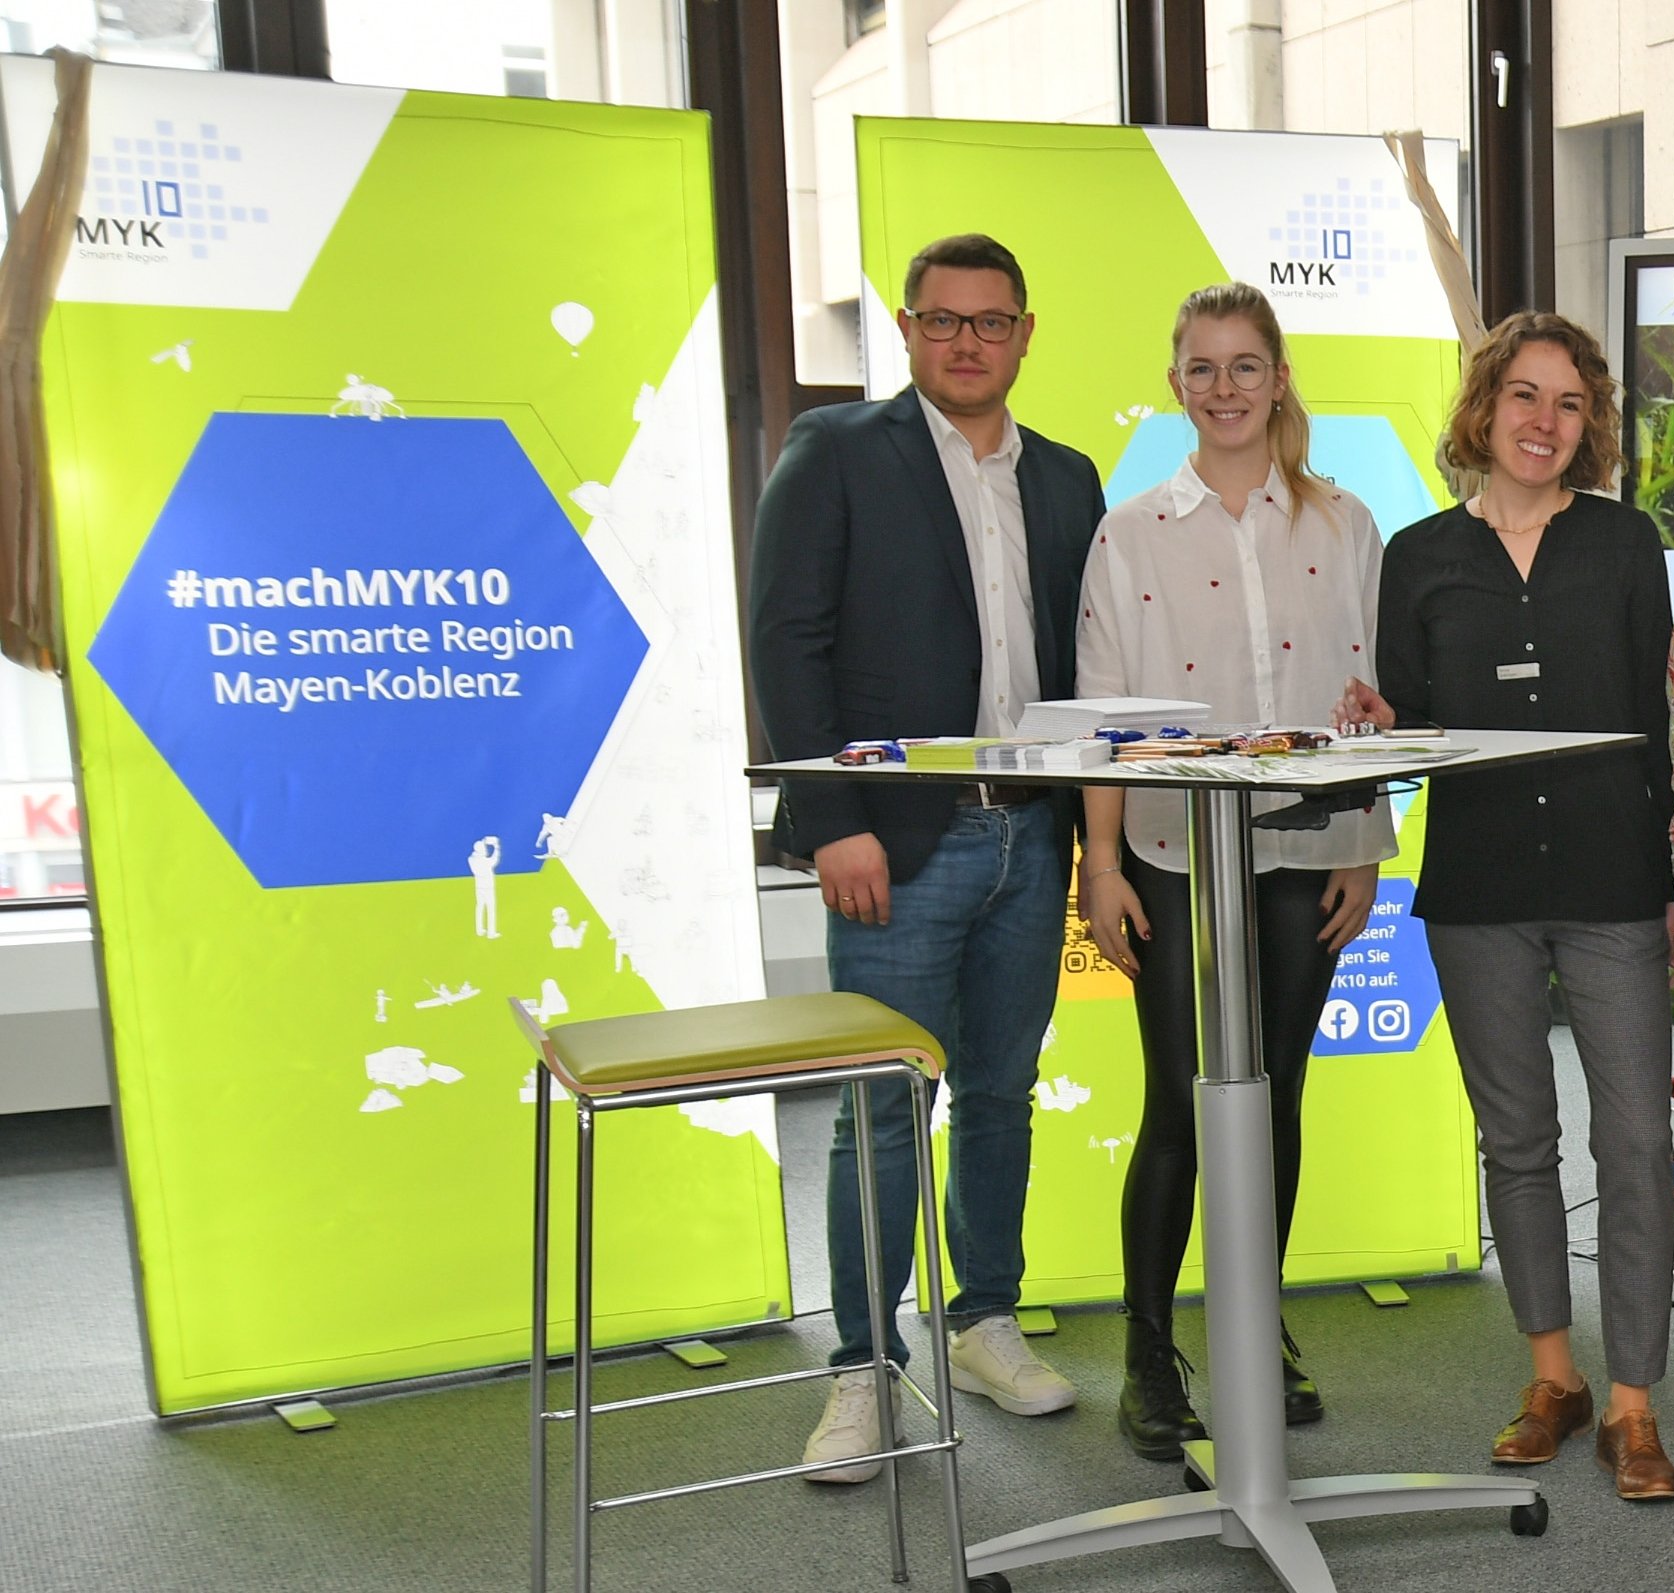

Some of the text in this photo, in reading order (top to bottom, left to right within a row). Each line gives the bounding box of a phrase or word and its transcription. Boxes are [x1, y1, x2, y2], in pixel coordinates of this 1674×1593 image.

[76, 216, 165, 248] MYK
[79, 249, 169, 264] Smarte Region
[1270, 262, 1336, 286] MYK
[1270, 288, 1339, 301] Smarte Region
[168, 568, 511, 608] #machMYK10
[208, 619, 574, 660] Die smarte Region
[213, 665, 523, 713] Mayen-Koblenz
[1367, 949, 1390, 963] Sie
[1330, 972, 1398, 988] YK10 auf:
